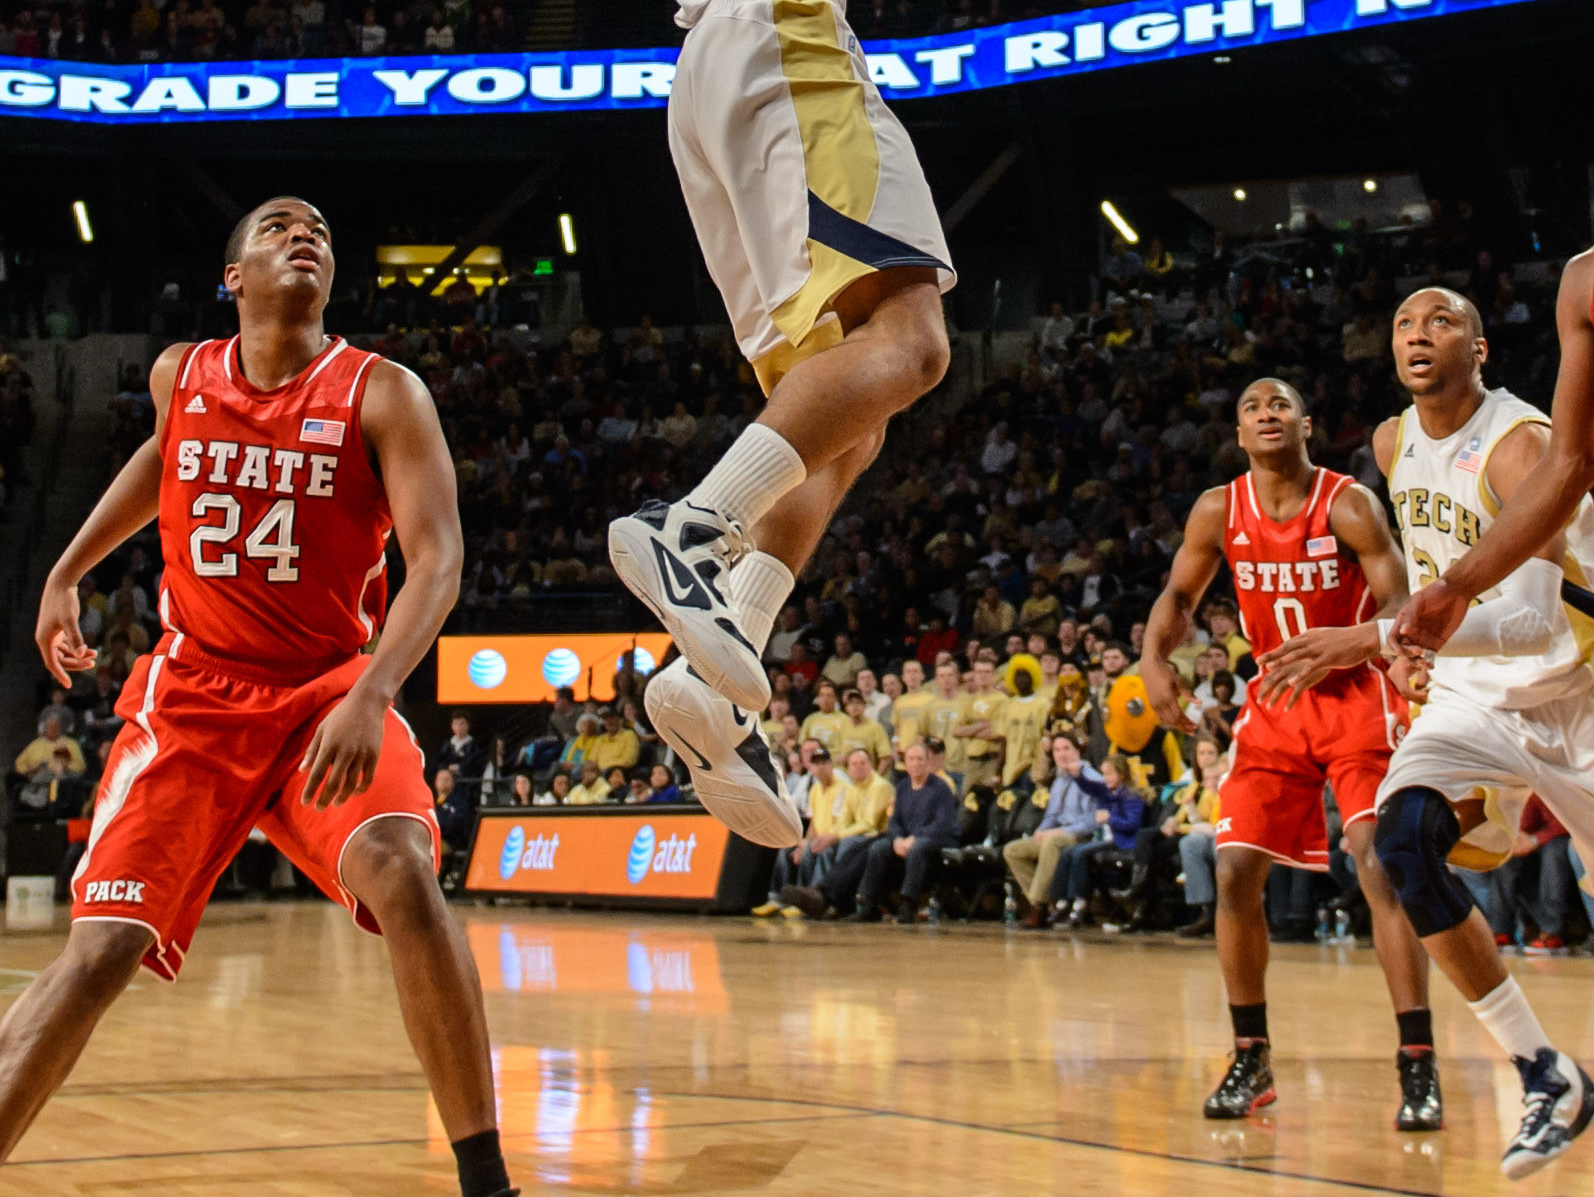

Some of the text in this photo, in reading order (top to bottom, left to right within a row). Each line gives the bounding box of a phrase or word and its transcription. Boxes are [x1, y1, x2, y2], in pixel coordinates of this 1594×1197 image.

[0, 69, 339, 114] GRADE
[373, 61, 677, 105] YOUR
[177, 439, 339, 497] STATE
[190, 492, 300, 582] 24
[1393, 488, 1480, 547] TECH
[1235, 559, 1340, 592] STATE
[1273, 598, 1308, 642] 0
[84, 880, 145, 904] PACK
